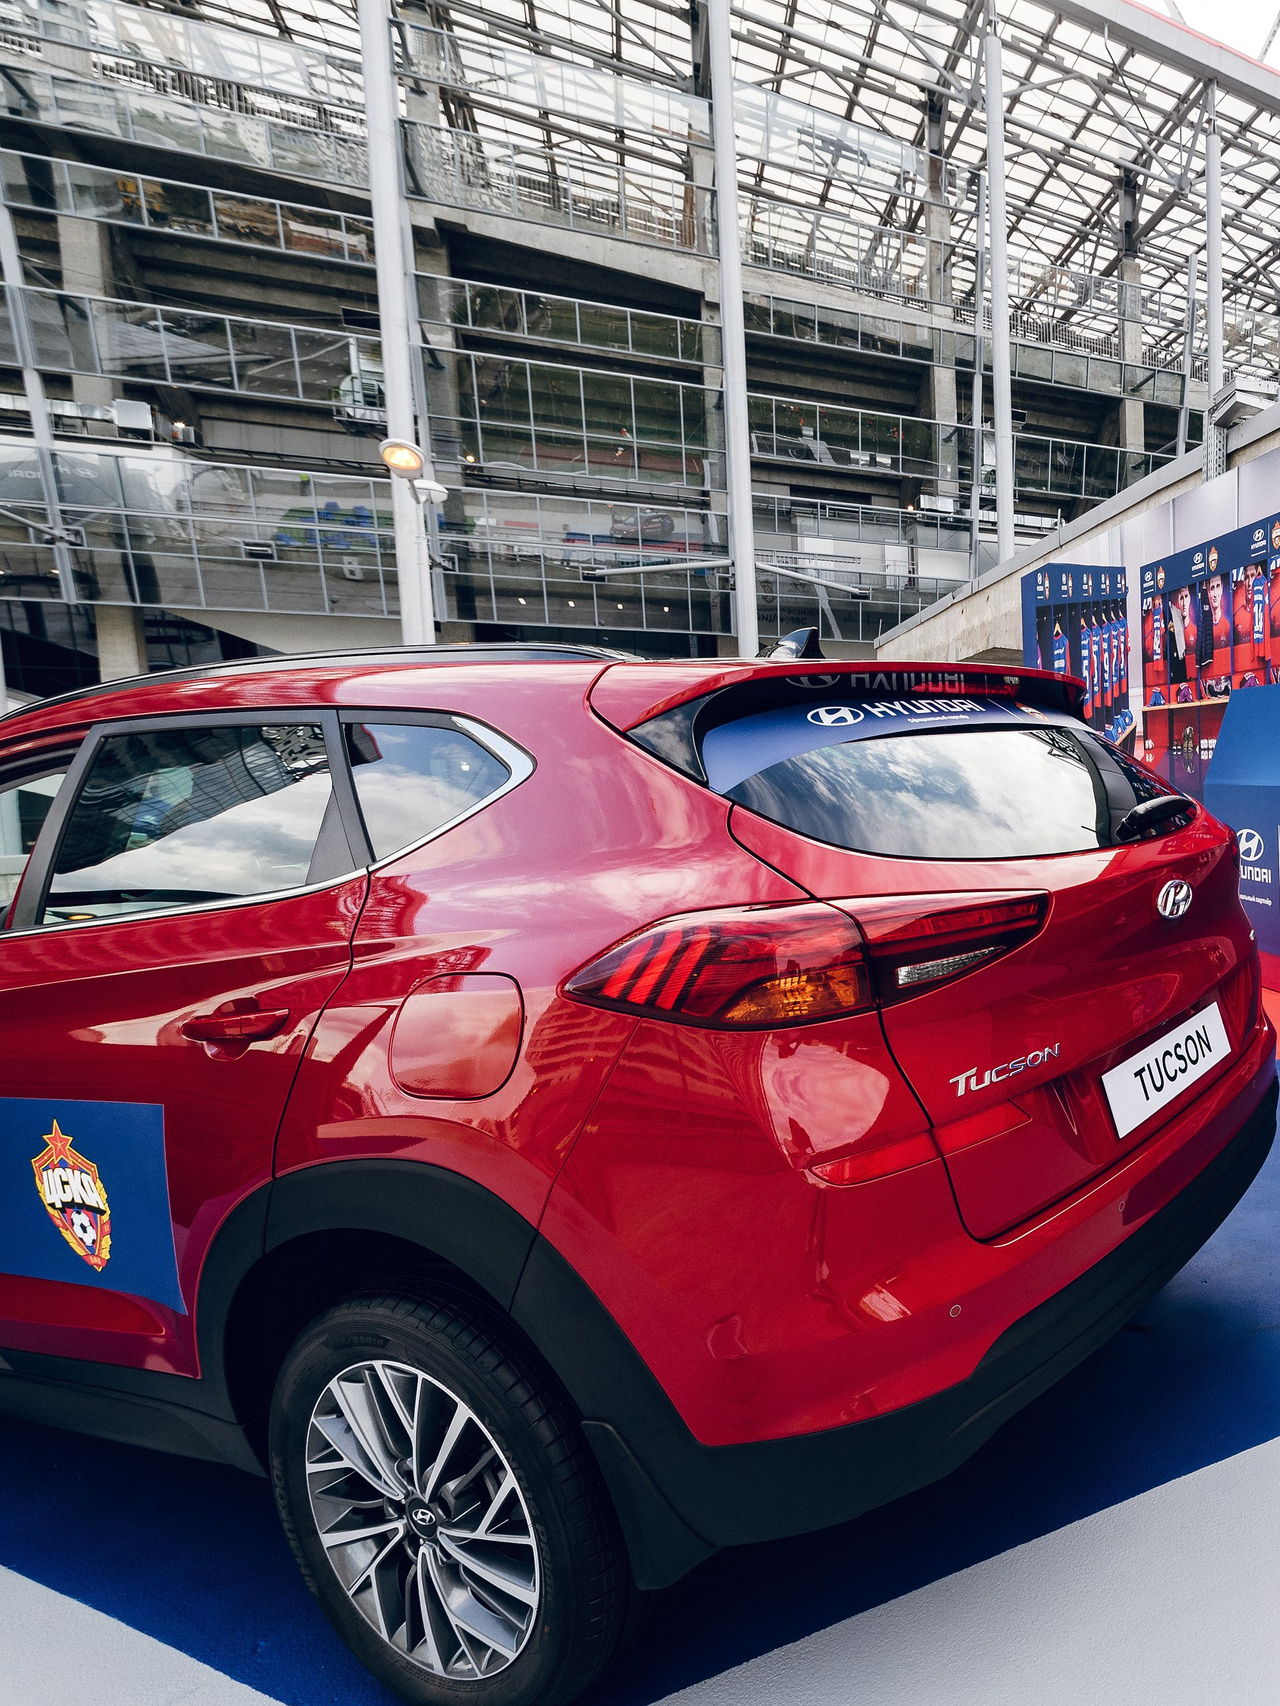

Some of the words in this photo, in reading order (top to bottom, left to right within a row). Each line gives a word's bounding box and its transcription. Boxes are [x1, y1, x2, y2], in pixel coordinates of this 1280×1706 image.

[861, 699, 986, 718] HYUNDAI
[1240, 865, 1272, 884] UNDAI
[1133, 1024, 1213, 1102] TUCSON
[42, 1167, 106, 1210] ЦСКА
